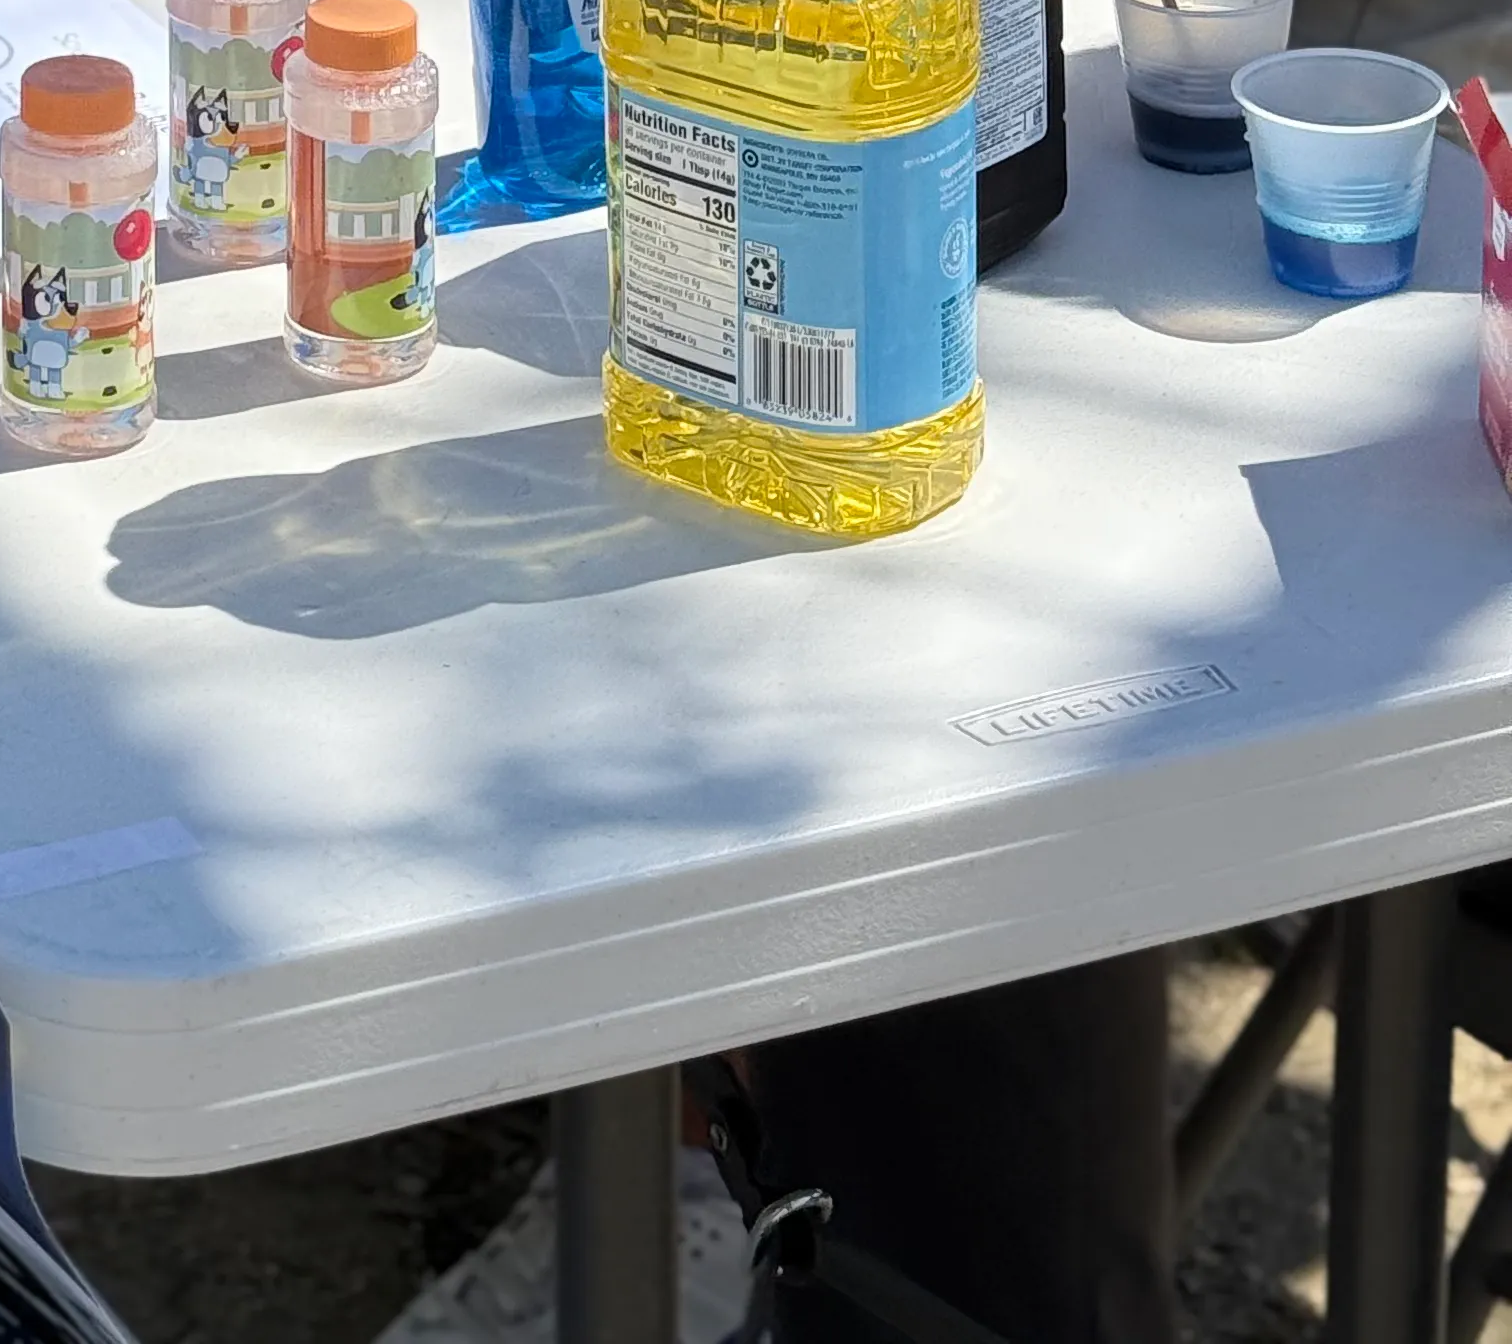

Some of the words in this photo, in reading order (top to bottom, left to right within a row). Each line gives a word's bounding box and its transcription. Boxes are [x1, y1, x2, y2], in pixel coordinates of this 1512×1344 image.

[624, 103, 687, 139] Nutrition
[692, 125, 736, 153] Facts
[624, 138, 653, 161] Serving
[655, 150, 672, 165] size
[689, 160, 710, 179] Tbsp
[712, 168, 736, 186] (14g)
[671, 141, 685, 154] per
[686, 146, 726, 166] container
[625, 173, 678, 207] Calories
[701, 195, 736, 224] 130
[990, 677, 1203, 737] LIFETIME
